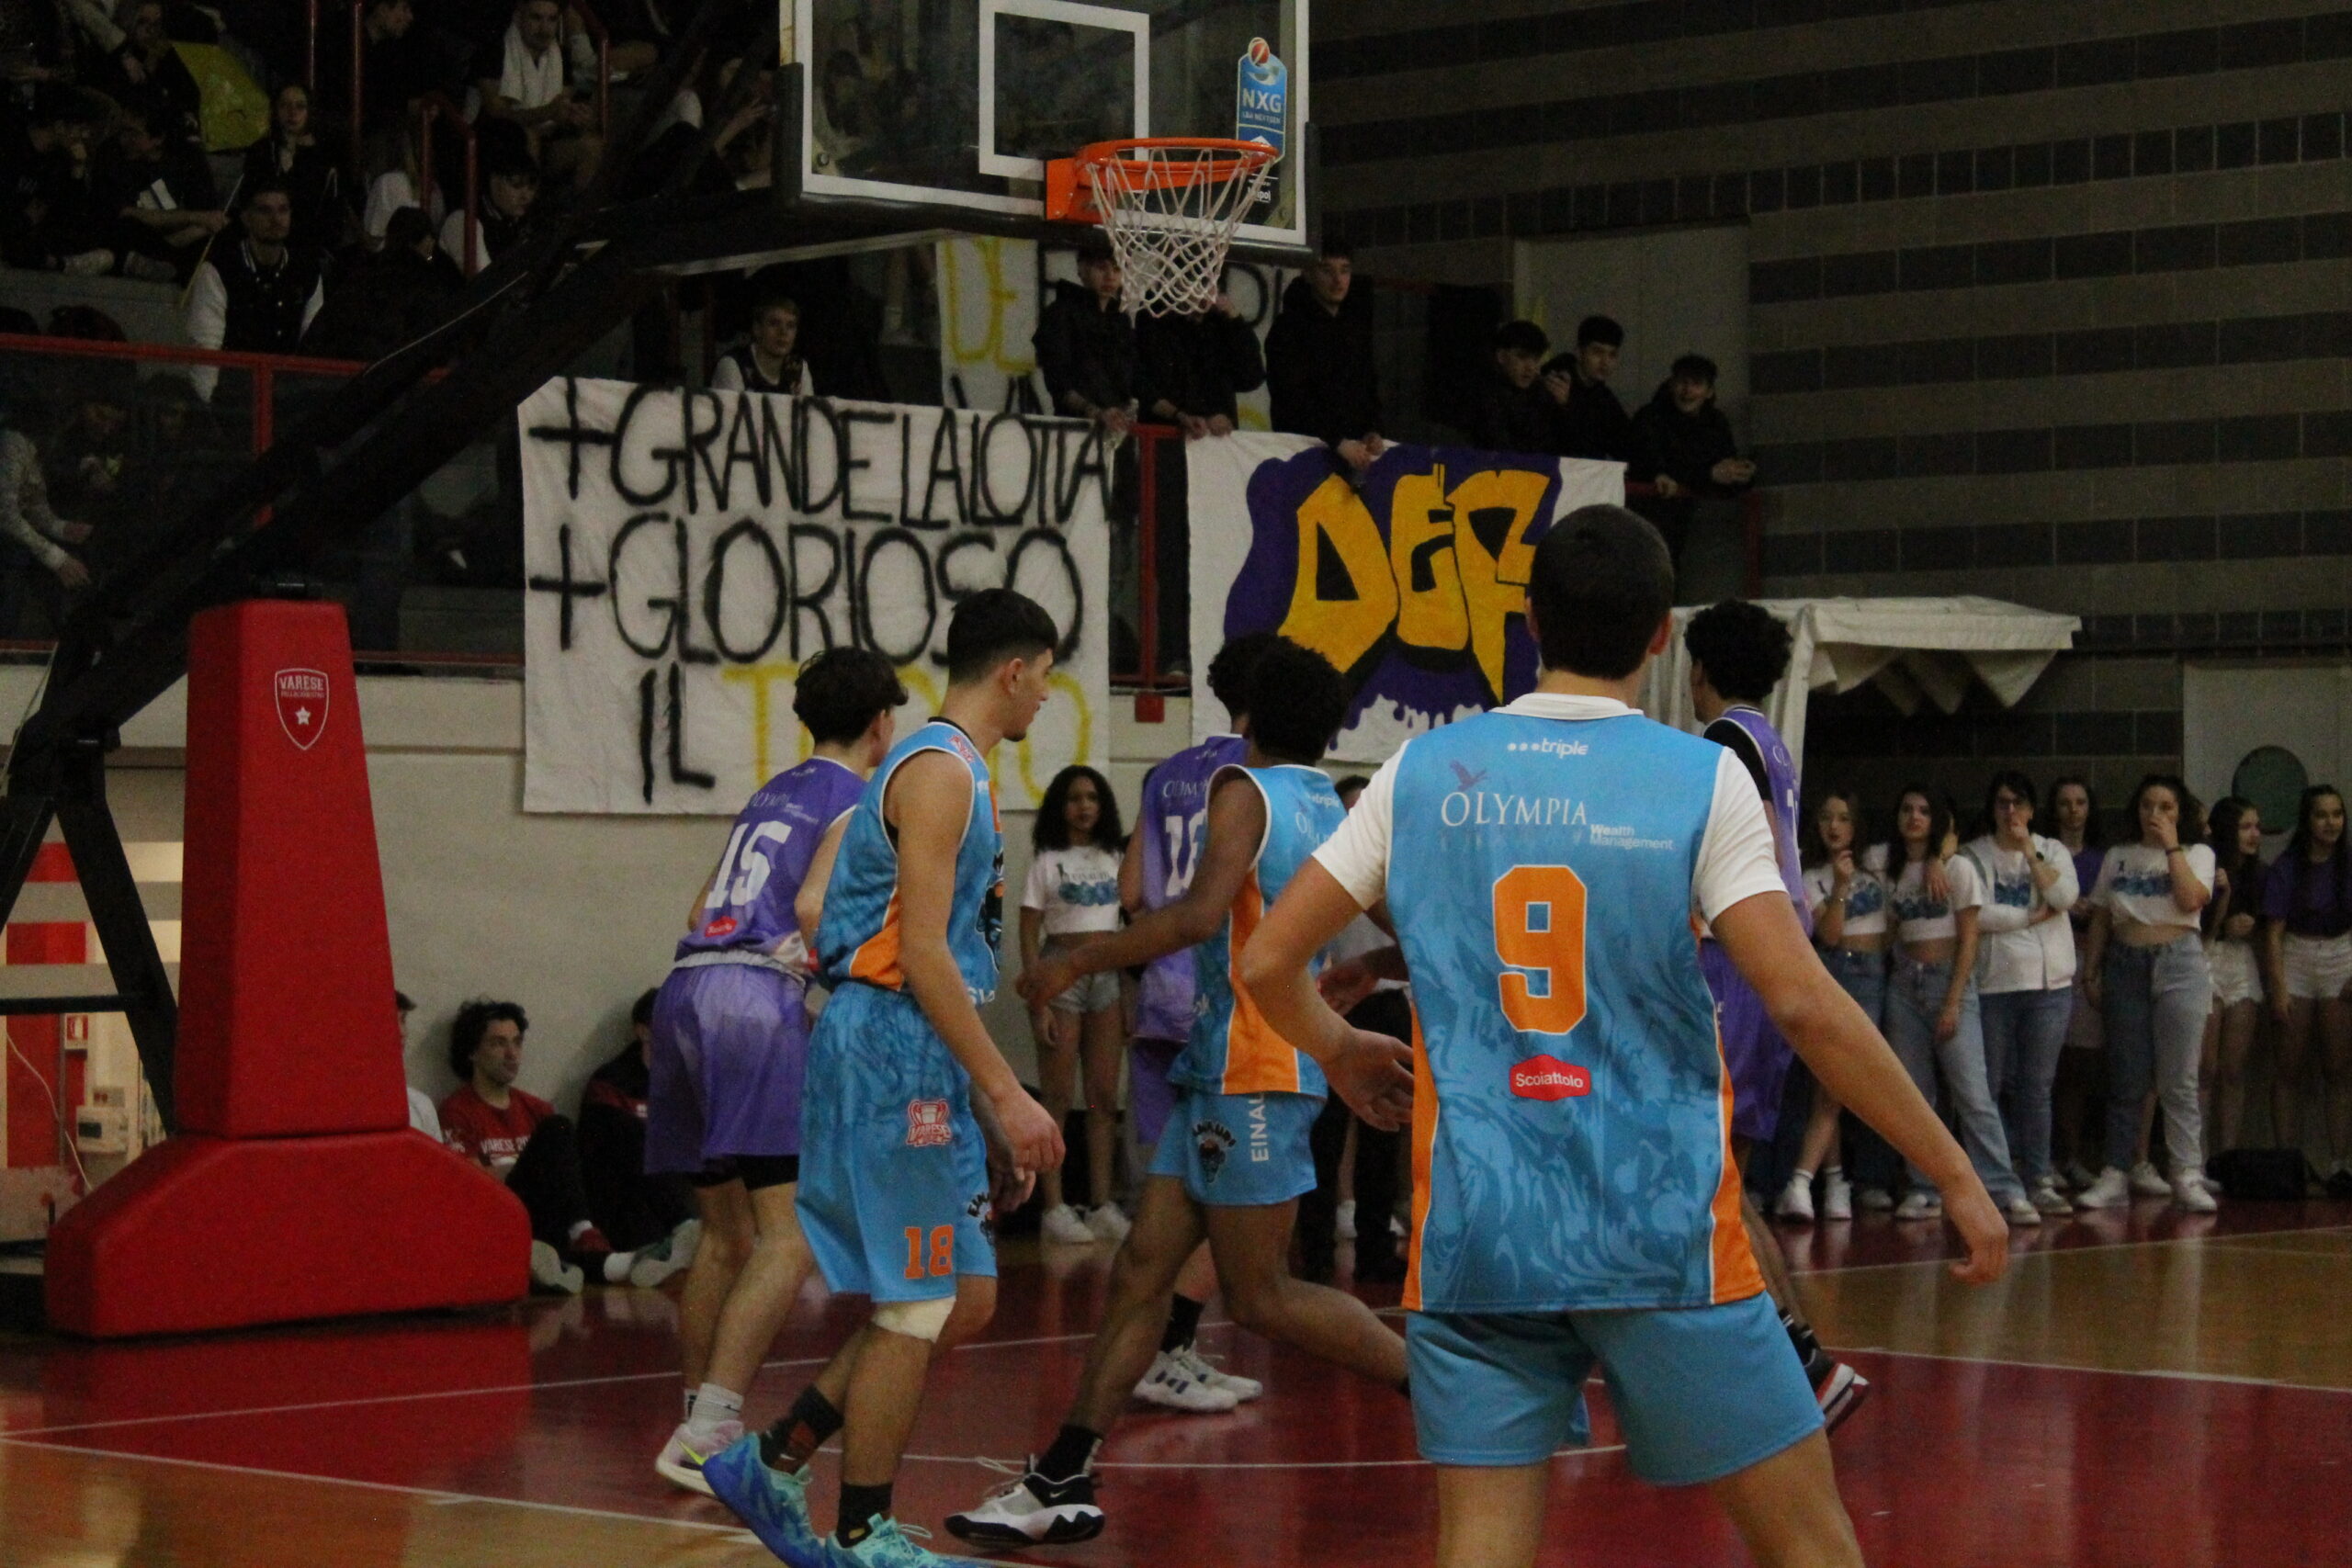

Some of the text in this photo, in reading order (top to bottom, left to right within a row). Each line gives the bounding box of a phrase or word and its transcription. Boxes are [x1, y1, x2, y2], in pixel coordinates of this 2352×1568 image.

[1243, 89, 1282, 113] NXG
[278, 674, 323, 691] VARESE
[641, 660, 717, 805] IL
[1542, 738, 1589, 759] triple
[1441, 791, 1588, 828] OLYMPIA
[1589, 824, 1635, 837] Wealth
[1589, 833, 1675, 850] Management
[704, 820, 793, 908] 15
[1492, 863, 1588, 1035] 9
[1515, 1071, 1584, 1089] Scoiattolo
[904, 1224, 954, 1279] 18
